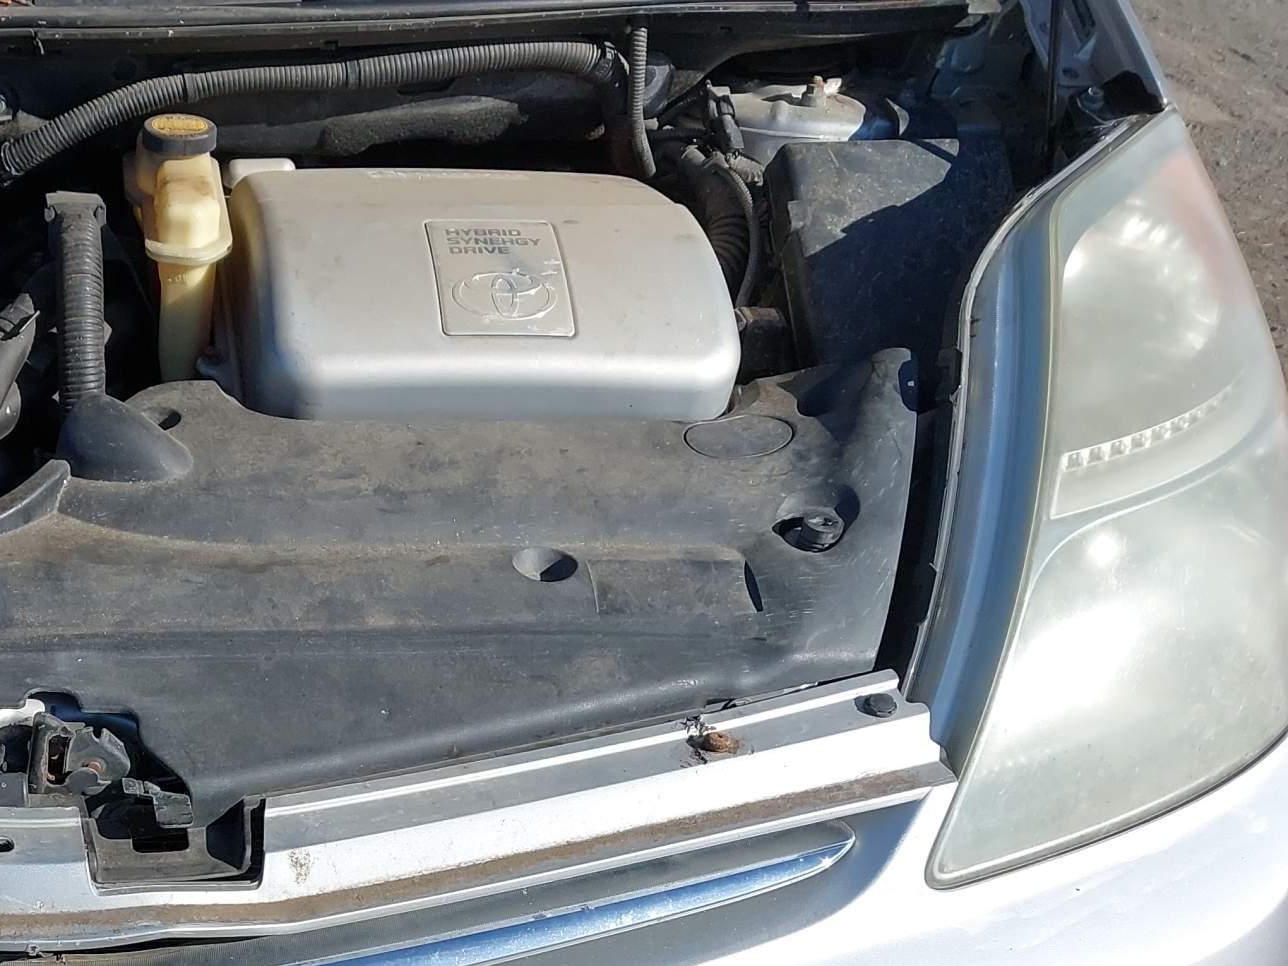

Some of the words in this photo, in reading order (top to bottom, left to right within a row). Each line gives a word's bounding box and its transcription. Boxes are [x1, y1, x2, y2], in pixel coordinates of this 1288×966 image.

[445, 228, 521, 236] HYBRID
[446, 237, 541, 246] SYNERGY
[449, 246, 510, 254] DRIVE
